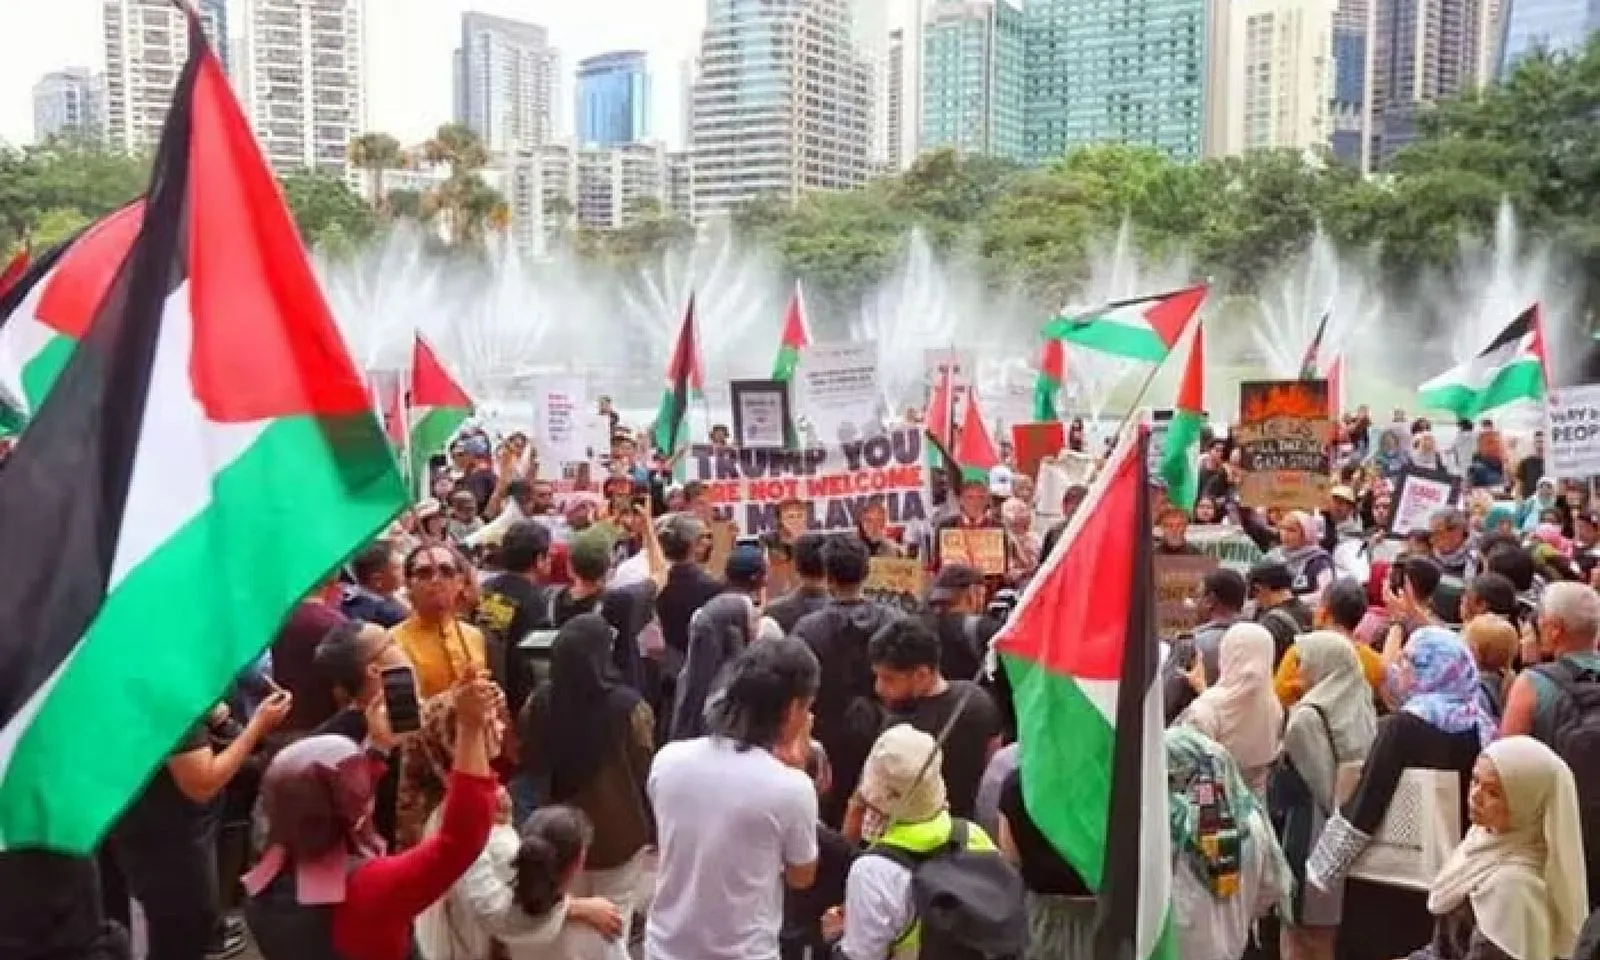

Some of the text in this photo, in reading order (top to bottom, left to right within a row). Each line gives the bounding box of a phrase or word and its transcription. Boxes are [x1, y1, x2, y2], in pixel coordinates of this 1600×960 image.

[692, 429, 920, 479] TRUMP YOU
[710, 466, 922, 502] RE NOT WELCOME
[746, 491, 925, 536] MLAYIA
